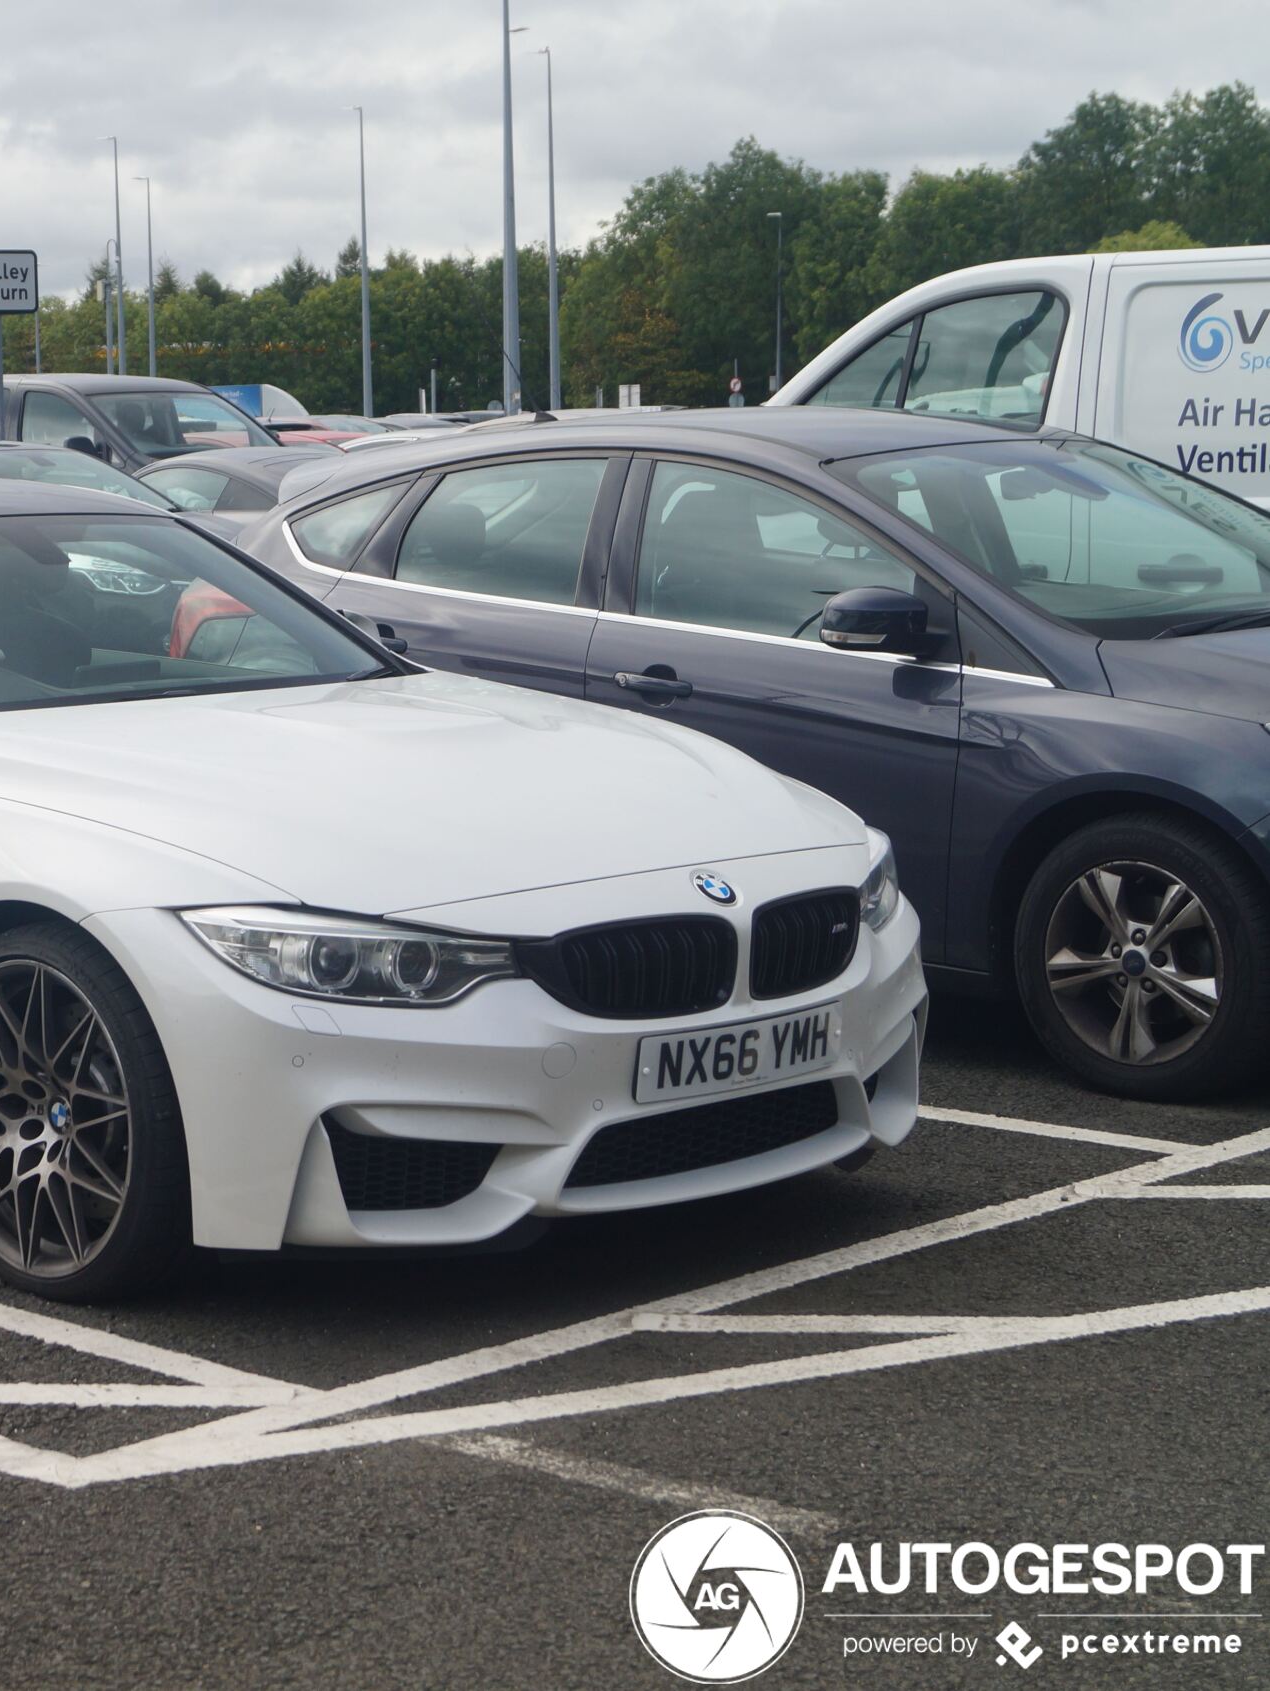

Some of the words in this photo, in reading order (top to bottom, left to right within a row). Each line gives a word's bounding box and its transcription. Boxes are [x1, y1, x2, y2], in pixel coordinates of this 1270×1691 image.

[1178, 397, 1224, 427] Air
[1176, 443, 1270, 473] Ventil
[657, 1028, 761, 1090] NX66
[771, 1011, 831, 1070] YMH
